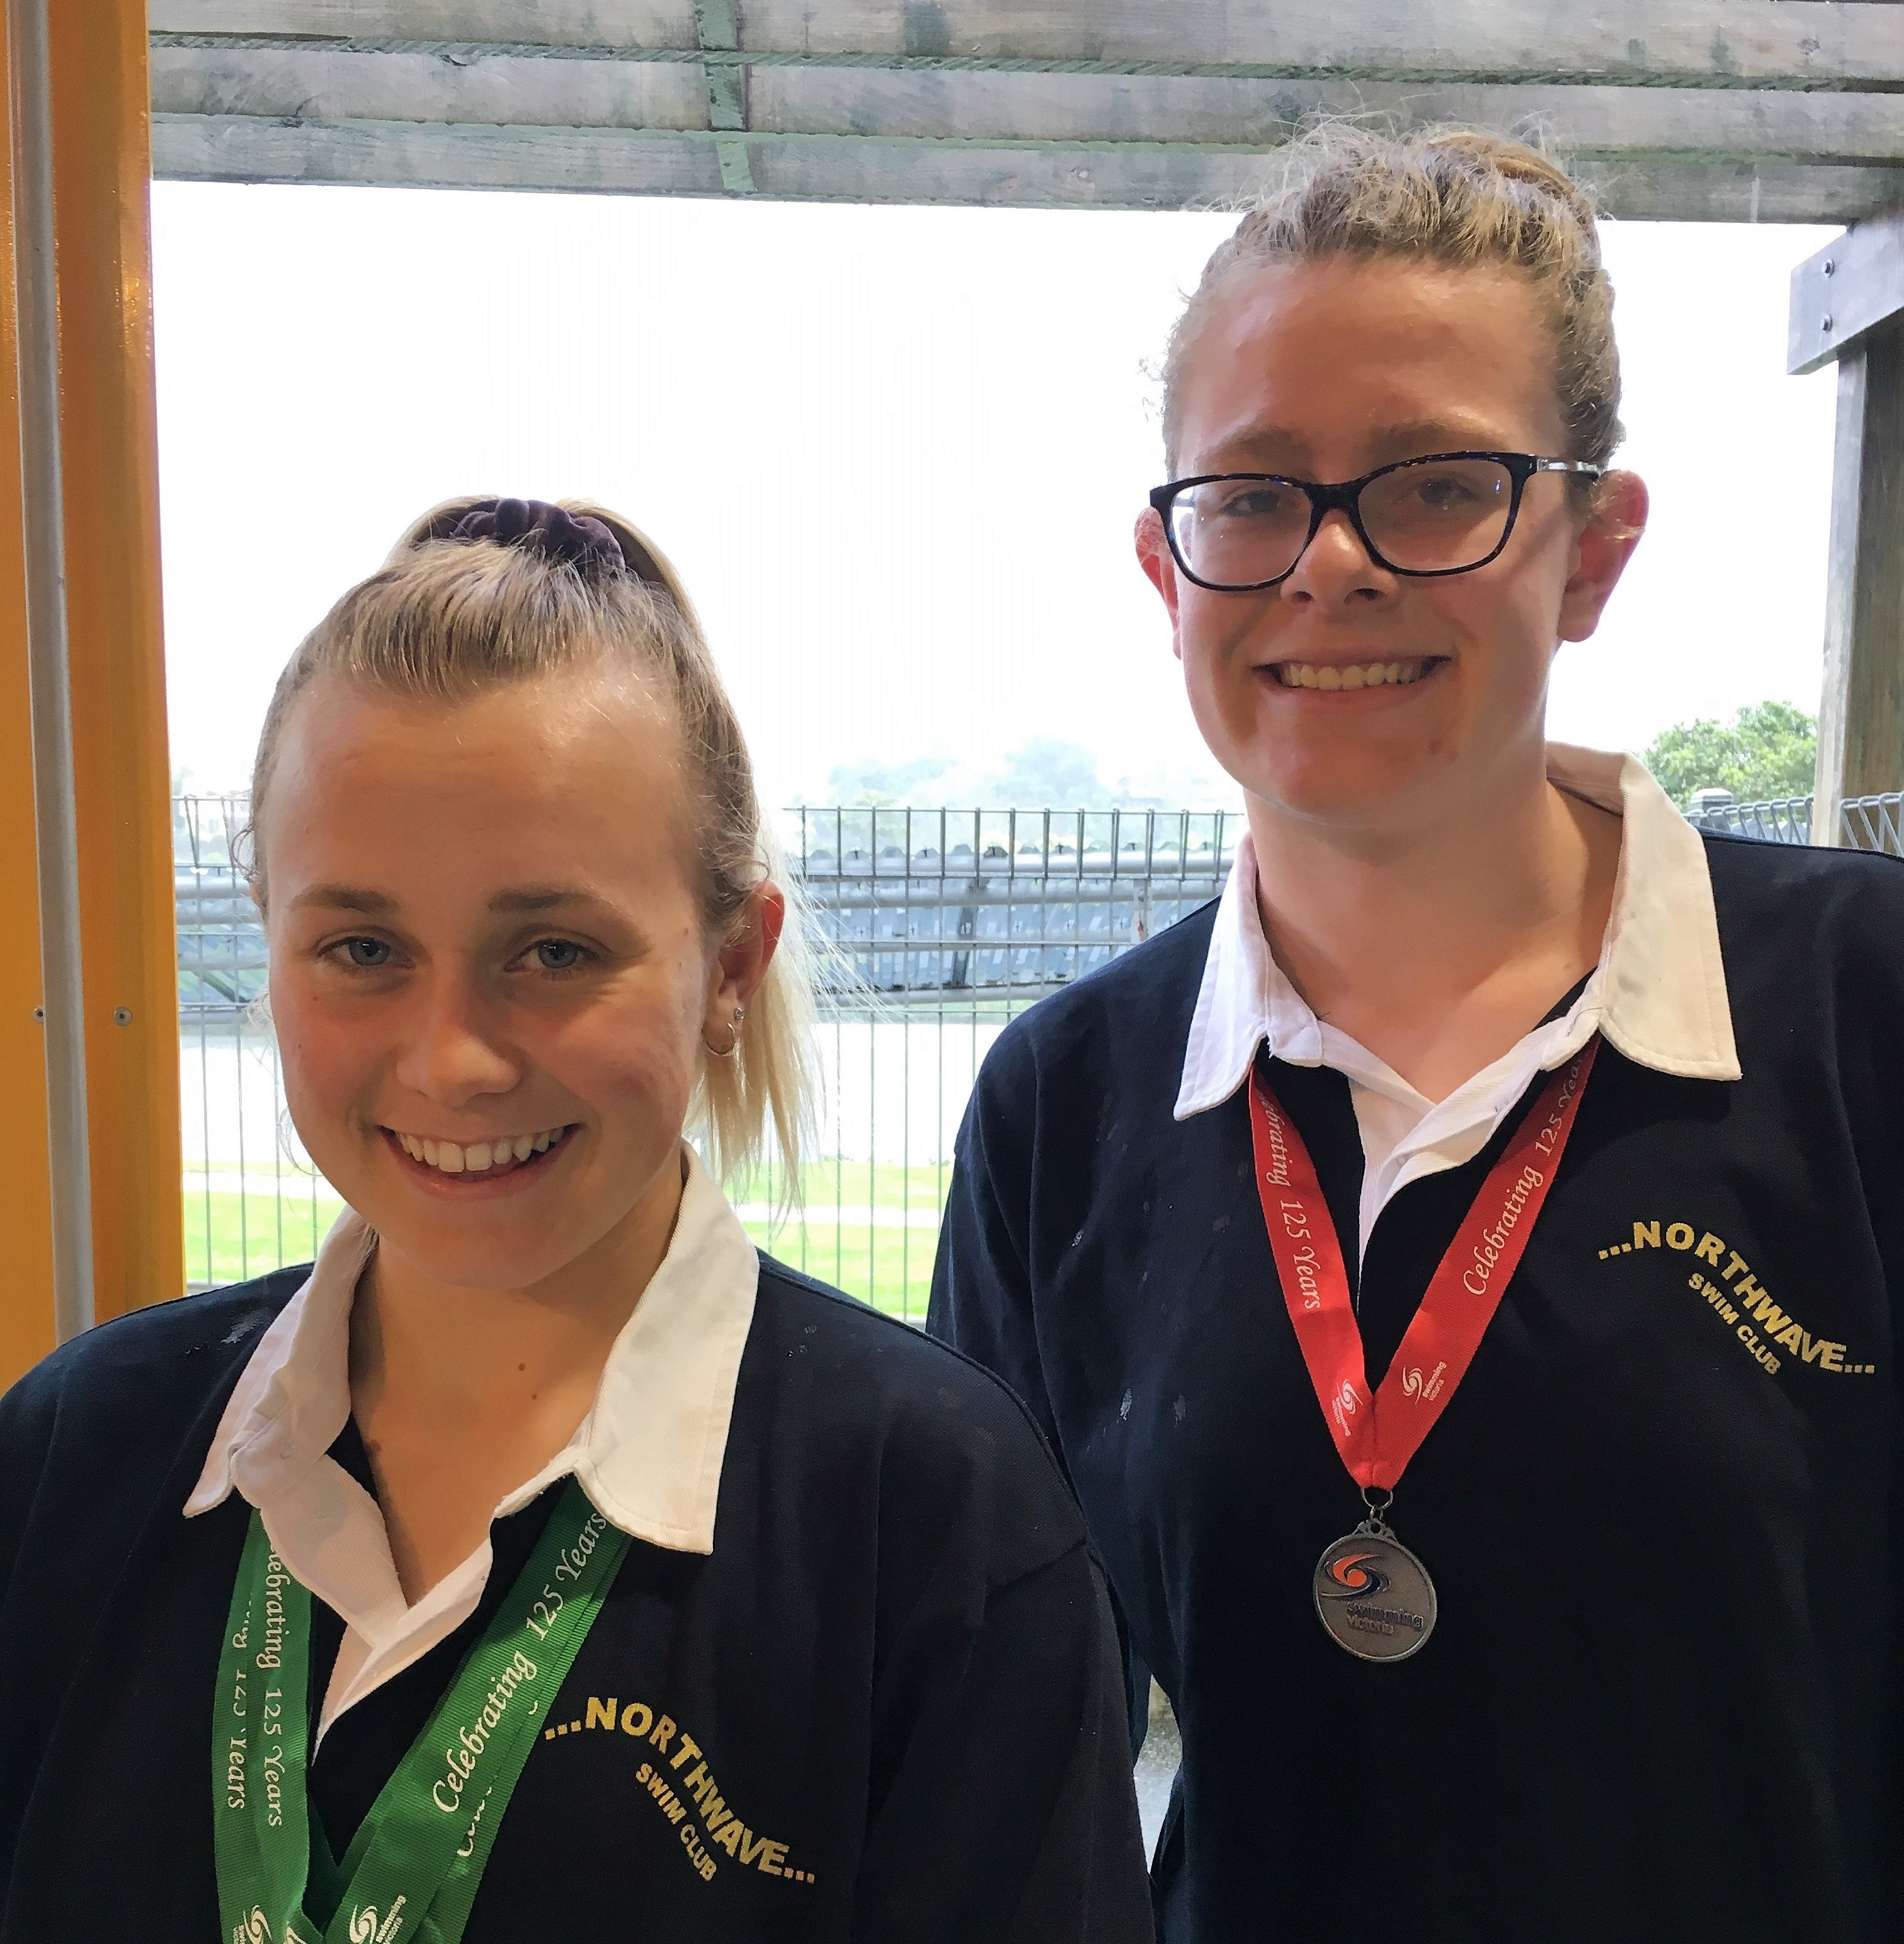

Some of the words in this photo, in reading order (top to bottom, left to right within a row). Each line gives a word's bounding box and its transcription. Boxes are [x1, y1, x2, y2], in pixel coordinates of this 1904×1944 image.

[1280, 1199, 1311, 1239] 125
[1463, 1165, 1544, 1295] Celebrating
[1535, 1113, 1562, 1157] 125
[1558, 1058, 1583, 1108] Yea
[1293, 1245, 1321, 1310] Years
[1688, 1272, 1740, 1325] SWIM
[1736, 1325, 1782, 1375] CLUB
[256, 1550, 290, 1669] ebrating
[263, 1688, 282, 1735] 125
[433, 1650, 537, 1812] Celebrating
[526, 1584, 563, 1641] 125
[555, 1512, 607, 1581] Years
[264, 1745, 285, 1827] Years
[636, 1763, 687, 1825] SWIM
[680, 1824, 717, 1882] CLUB
